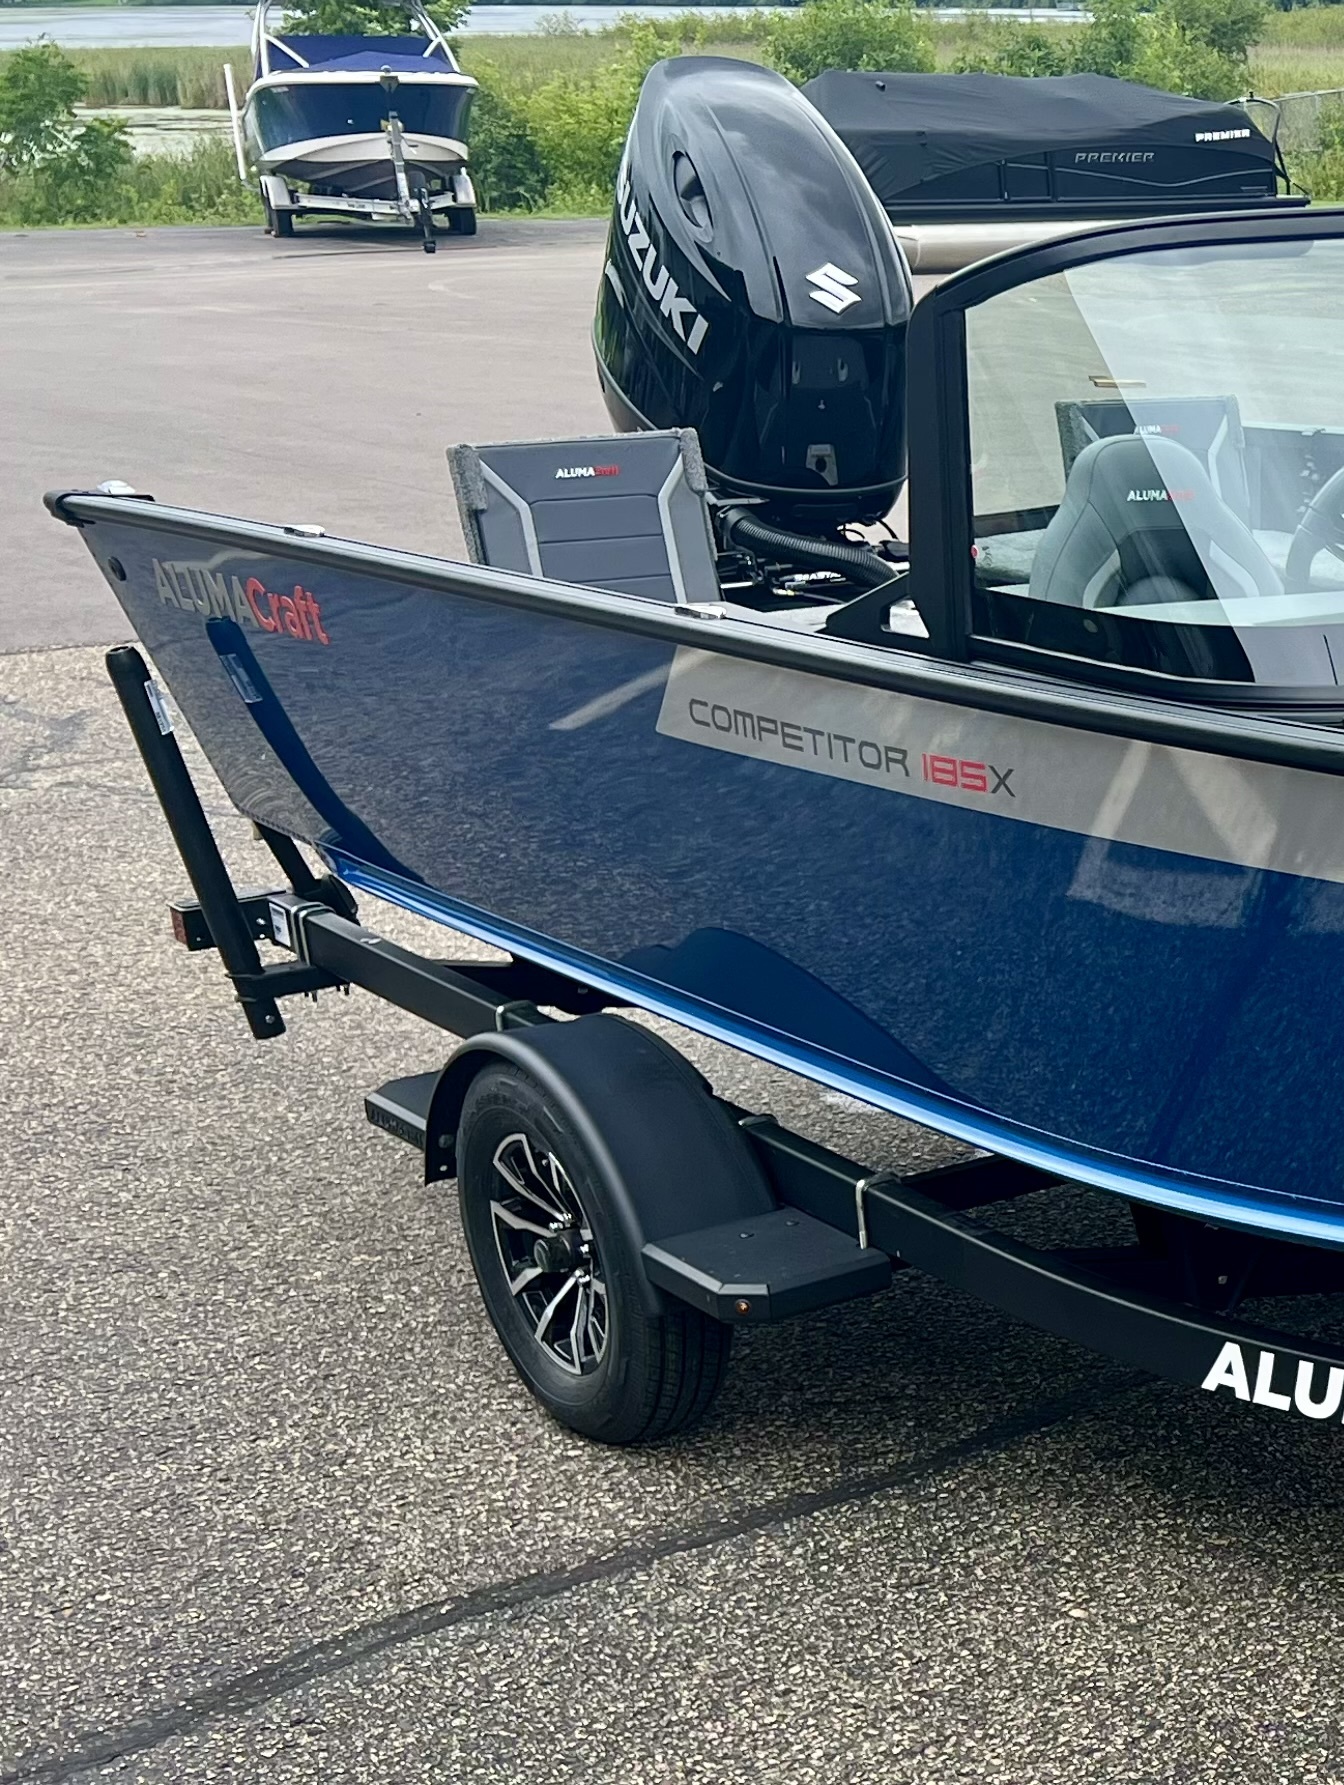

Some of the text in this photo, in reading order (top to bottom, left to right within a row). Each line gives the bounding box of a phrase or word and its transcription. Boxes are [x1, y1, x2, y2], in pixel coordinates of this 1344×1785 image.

[1074, 152, 1155, 163] PREMIER
[1195, 128, 1250, 143] PREMIER
[155, 558, 329, 646] ALUMACraft
[689, 698, 1016, 797] COMPETITOR 185X
